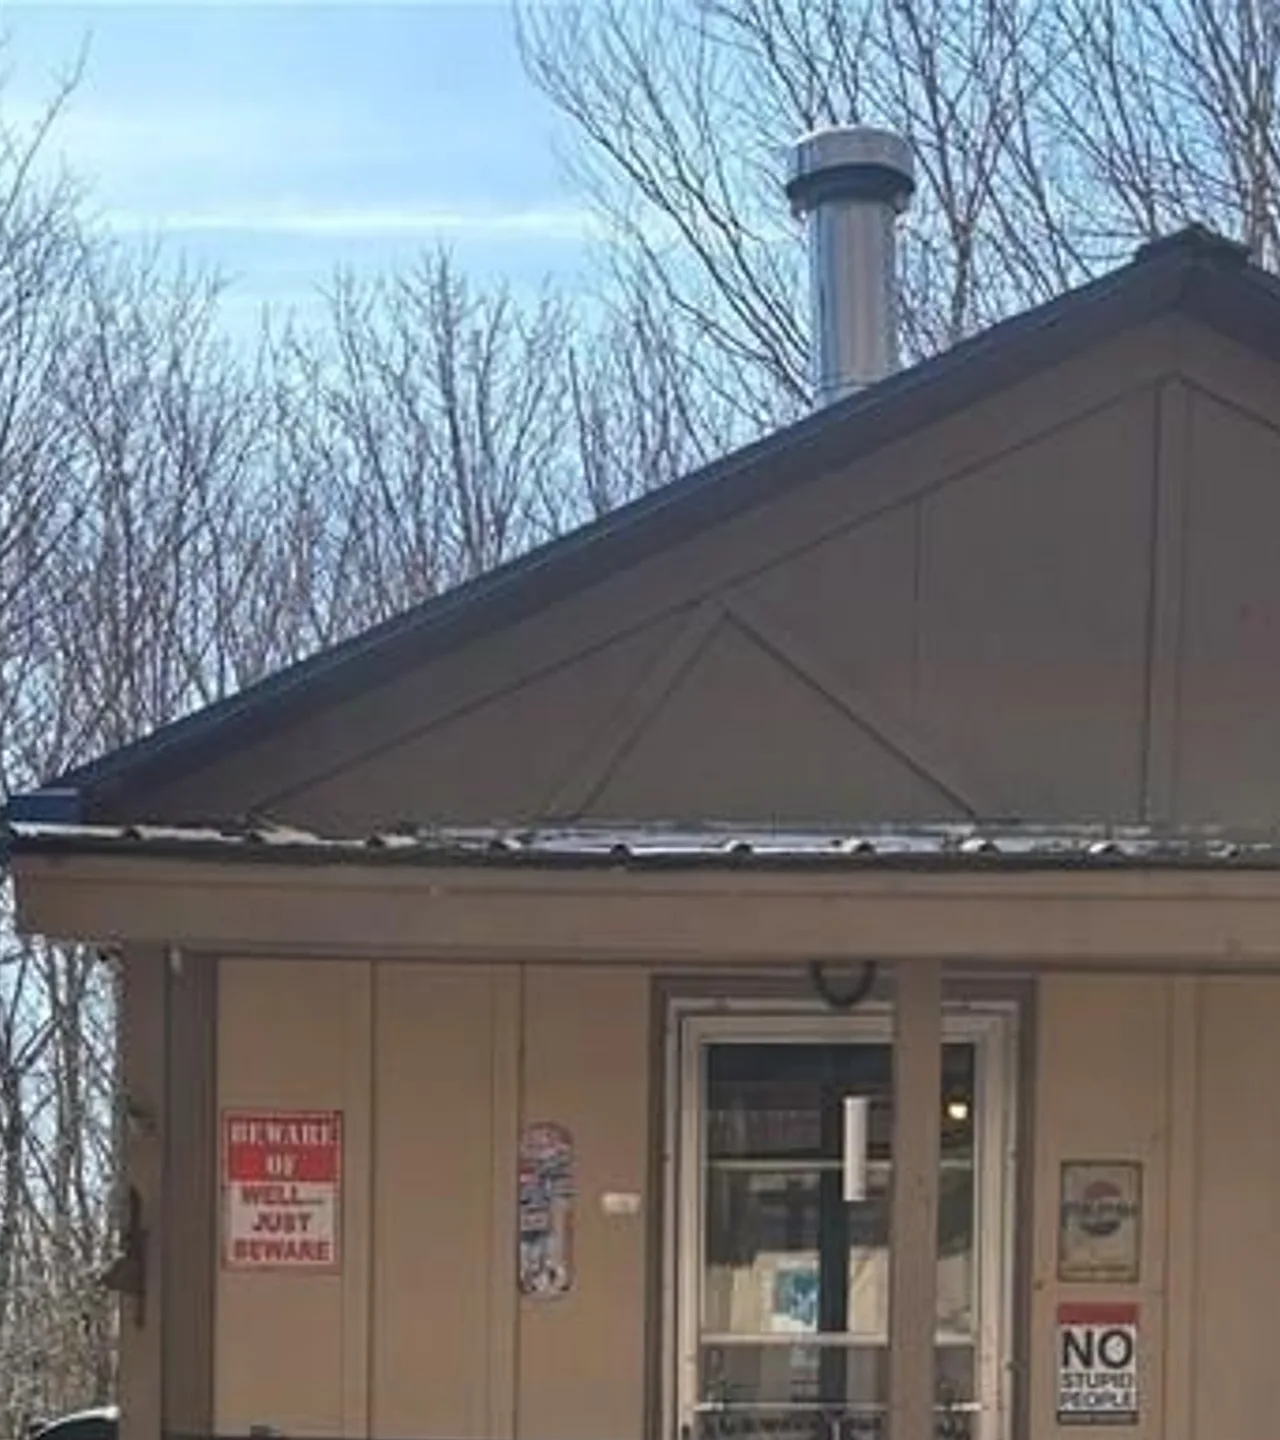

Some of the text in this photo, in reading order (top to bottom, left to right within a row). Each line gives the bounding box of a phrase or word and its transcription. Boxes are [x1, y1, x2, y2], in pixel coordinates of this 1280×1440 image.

[229, 1121, 336, 1145] BEWARE
[265, 1152, 299, 1178] OF
[252, 1211, 312, 1234] JUST
[233, 1239, 331, 1262] BEWARE
[1061, 1328, 1134, 1369] NO
[1061, 1372, 1133, 1389] STUPID
